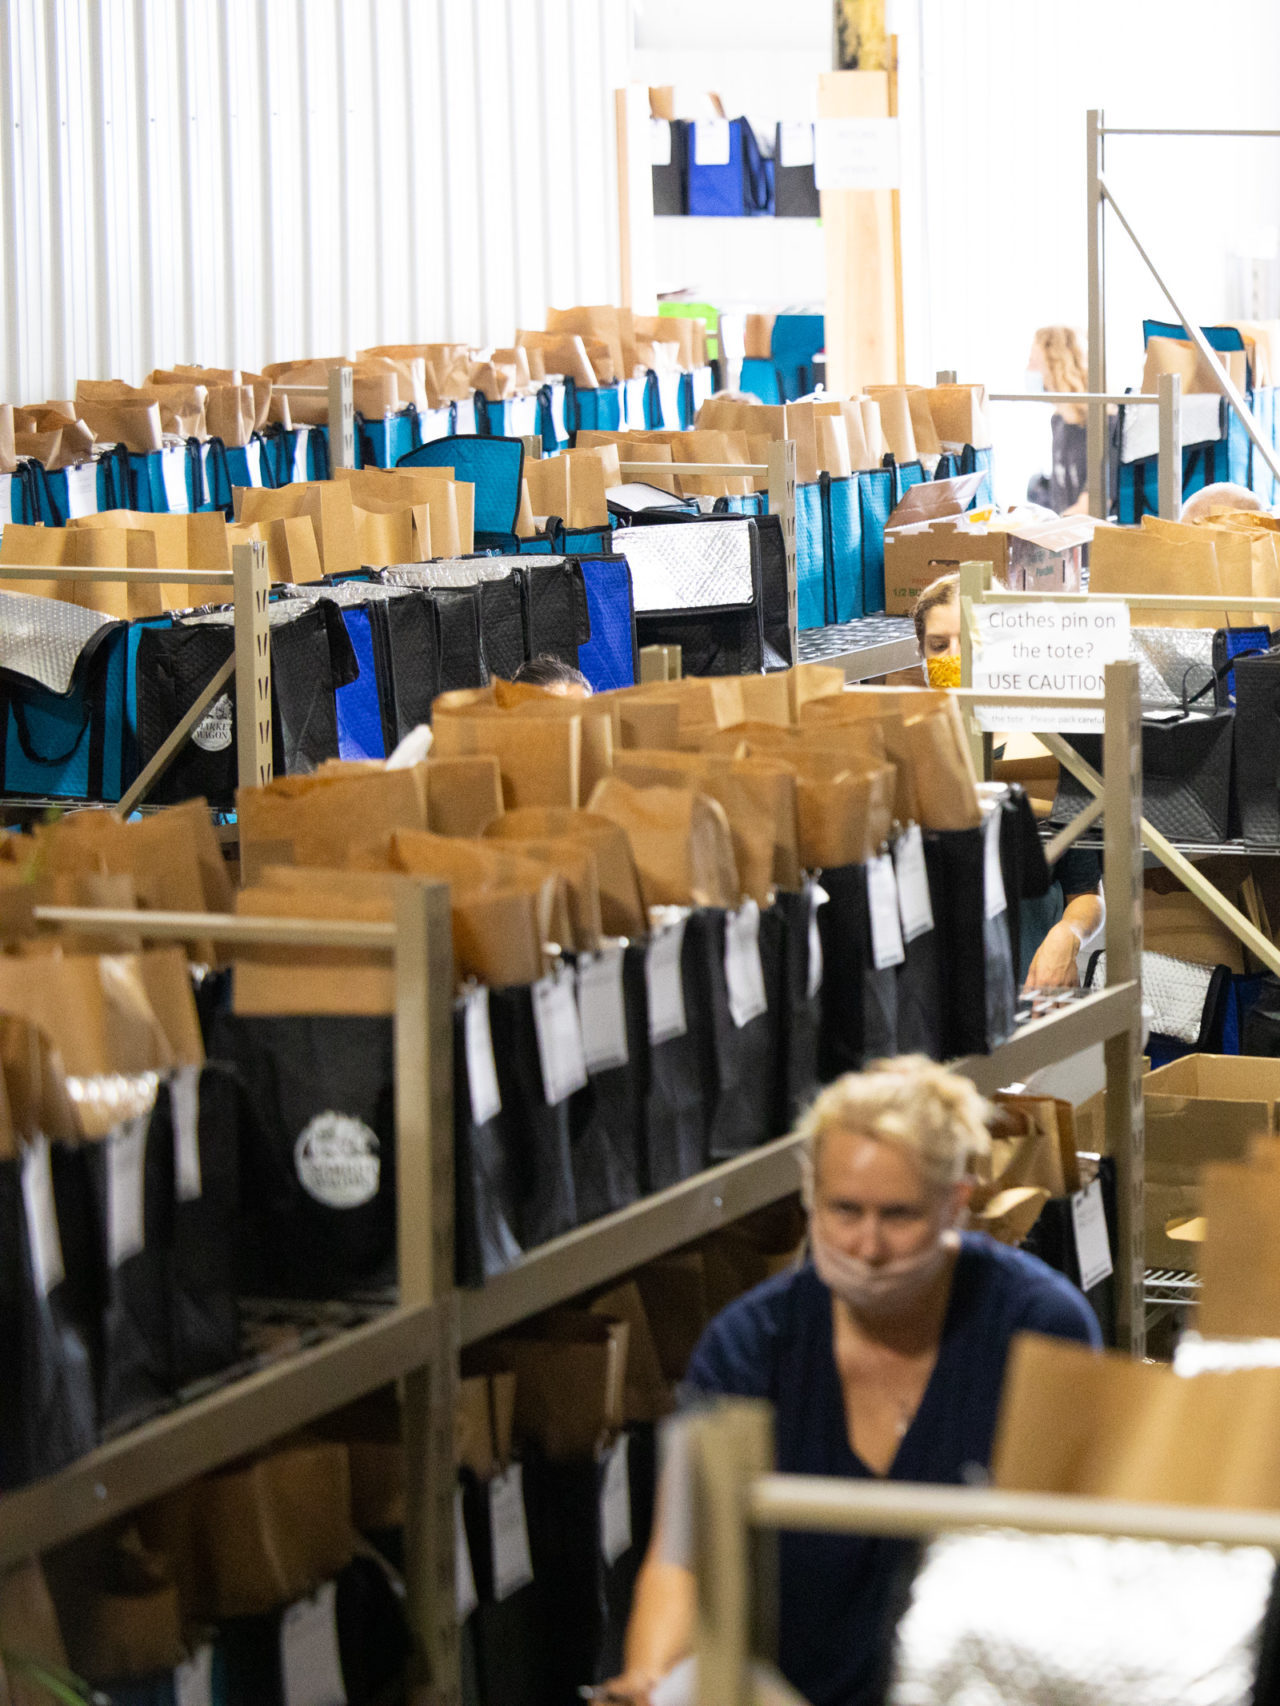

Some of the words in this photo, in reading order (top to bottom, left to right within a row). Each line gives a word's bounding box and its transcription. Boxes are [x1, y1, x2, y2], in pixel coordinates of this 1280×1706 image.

[989, 611, 1055, 629] Clothes
[1061, 611, 1088, 631] pin
[1094, 616, 1116, 629] on
[1013, 642, 1041, 659] the
[1047, 642, 1095, 659] tote?
[988, 674, 1022, 690] USE
[196, 730, 228, 739] WAGON
